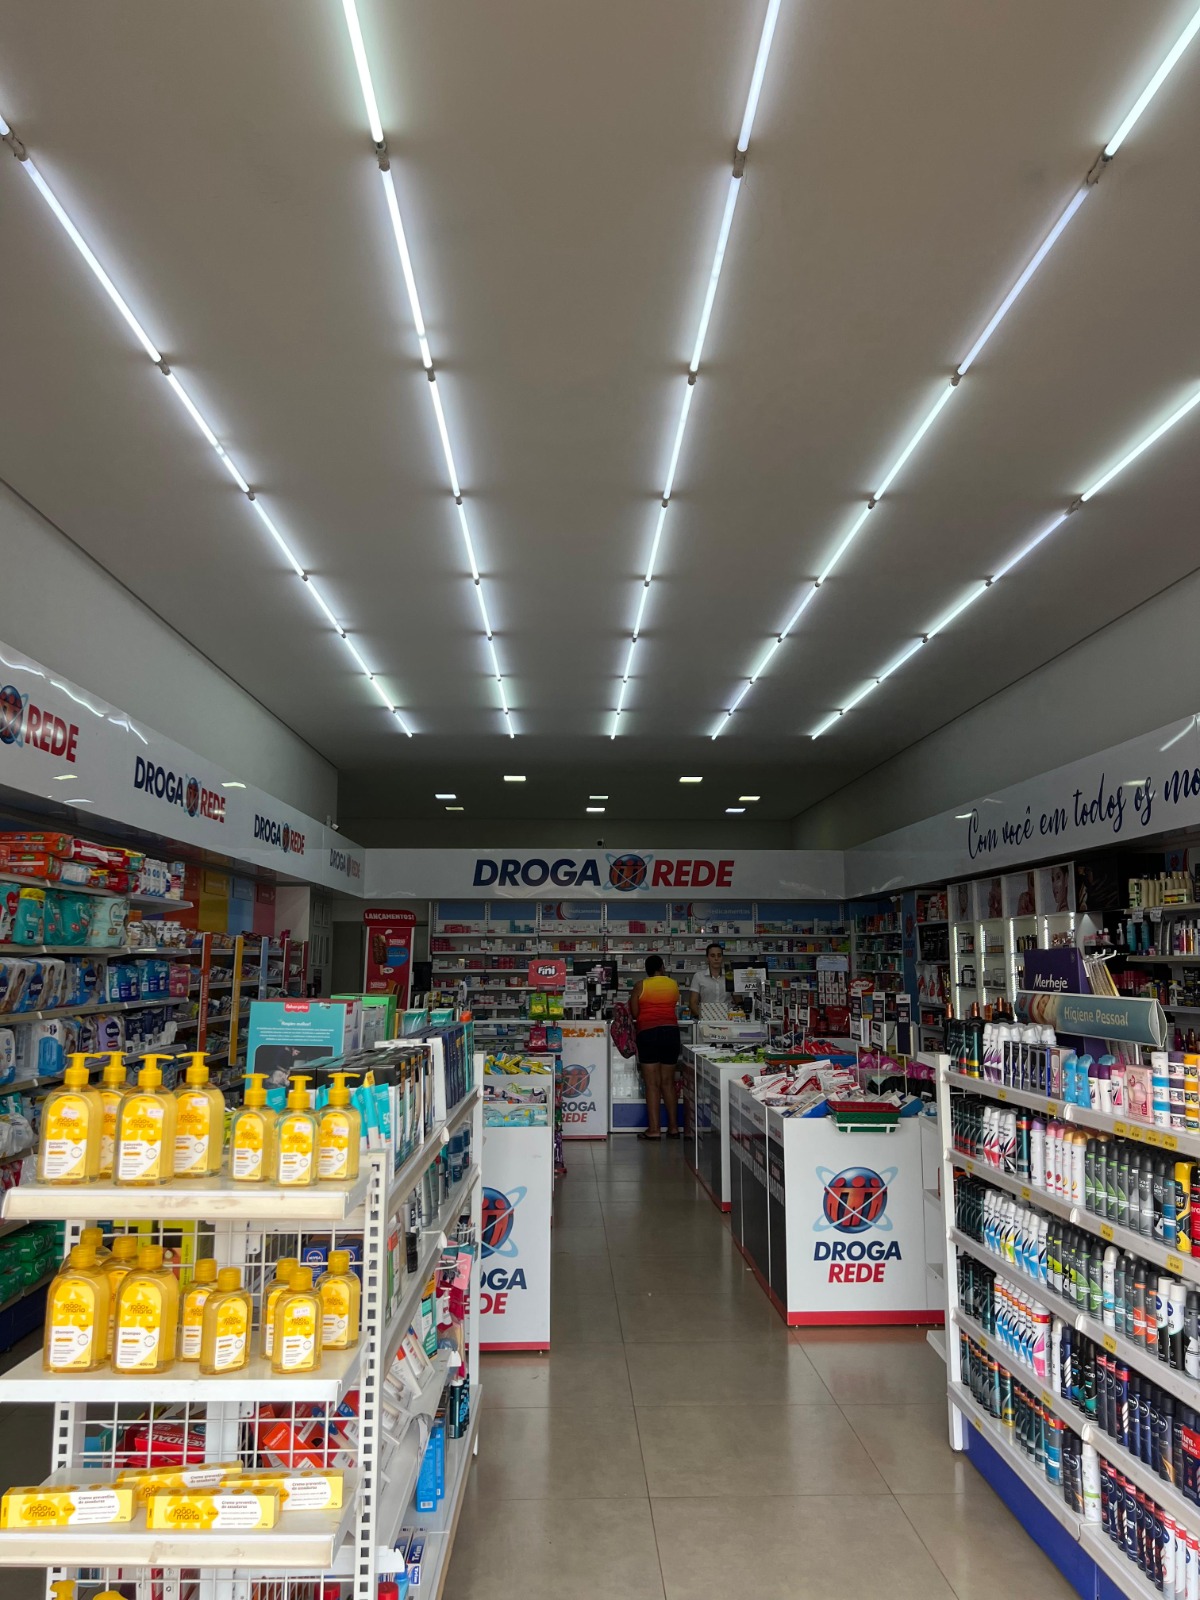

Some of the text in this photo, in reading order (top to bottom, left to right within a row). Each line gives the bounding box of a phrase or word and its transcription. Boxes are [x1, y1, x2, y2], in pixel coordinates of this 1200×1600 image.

[25, 704, 79, 763] REDE
[134, 755, 226, 824] DROGA REDE
[968, 808, 998, 860] Com
[1001, 805, 1034, 846] você
[1039, 805, 1068, 836] em
[1073, 772, 1127, 833] todos
[1134, 776, 1156, 826] os
[254, 814, 305, 855] DROGA REDE
[329, 848, 346, 872] DROGA
[472, 859, 734, 887] DROGA REDE
[364, 912, 415, 921] LANÇAMENTOS!
[538, 965, 556, 976] Fini
[1033, 973, 1068, 992] Merheje
[1064, 1006, 1129, 1027] Higiene Pessoal
[560, 1101, 597, 1112] ROGA
[813, 1240, 902, 1261] DROGA
[828, 1263, 886, 1283] REDE
[29, 1504, 48, 1514] joão
[32, 1510, 56, 1518] maria
[173, 1507, 191, 1517] joão
[411, 1545, 422, 1561] Trim
